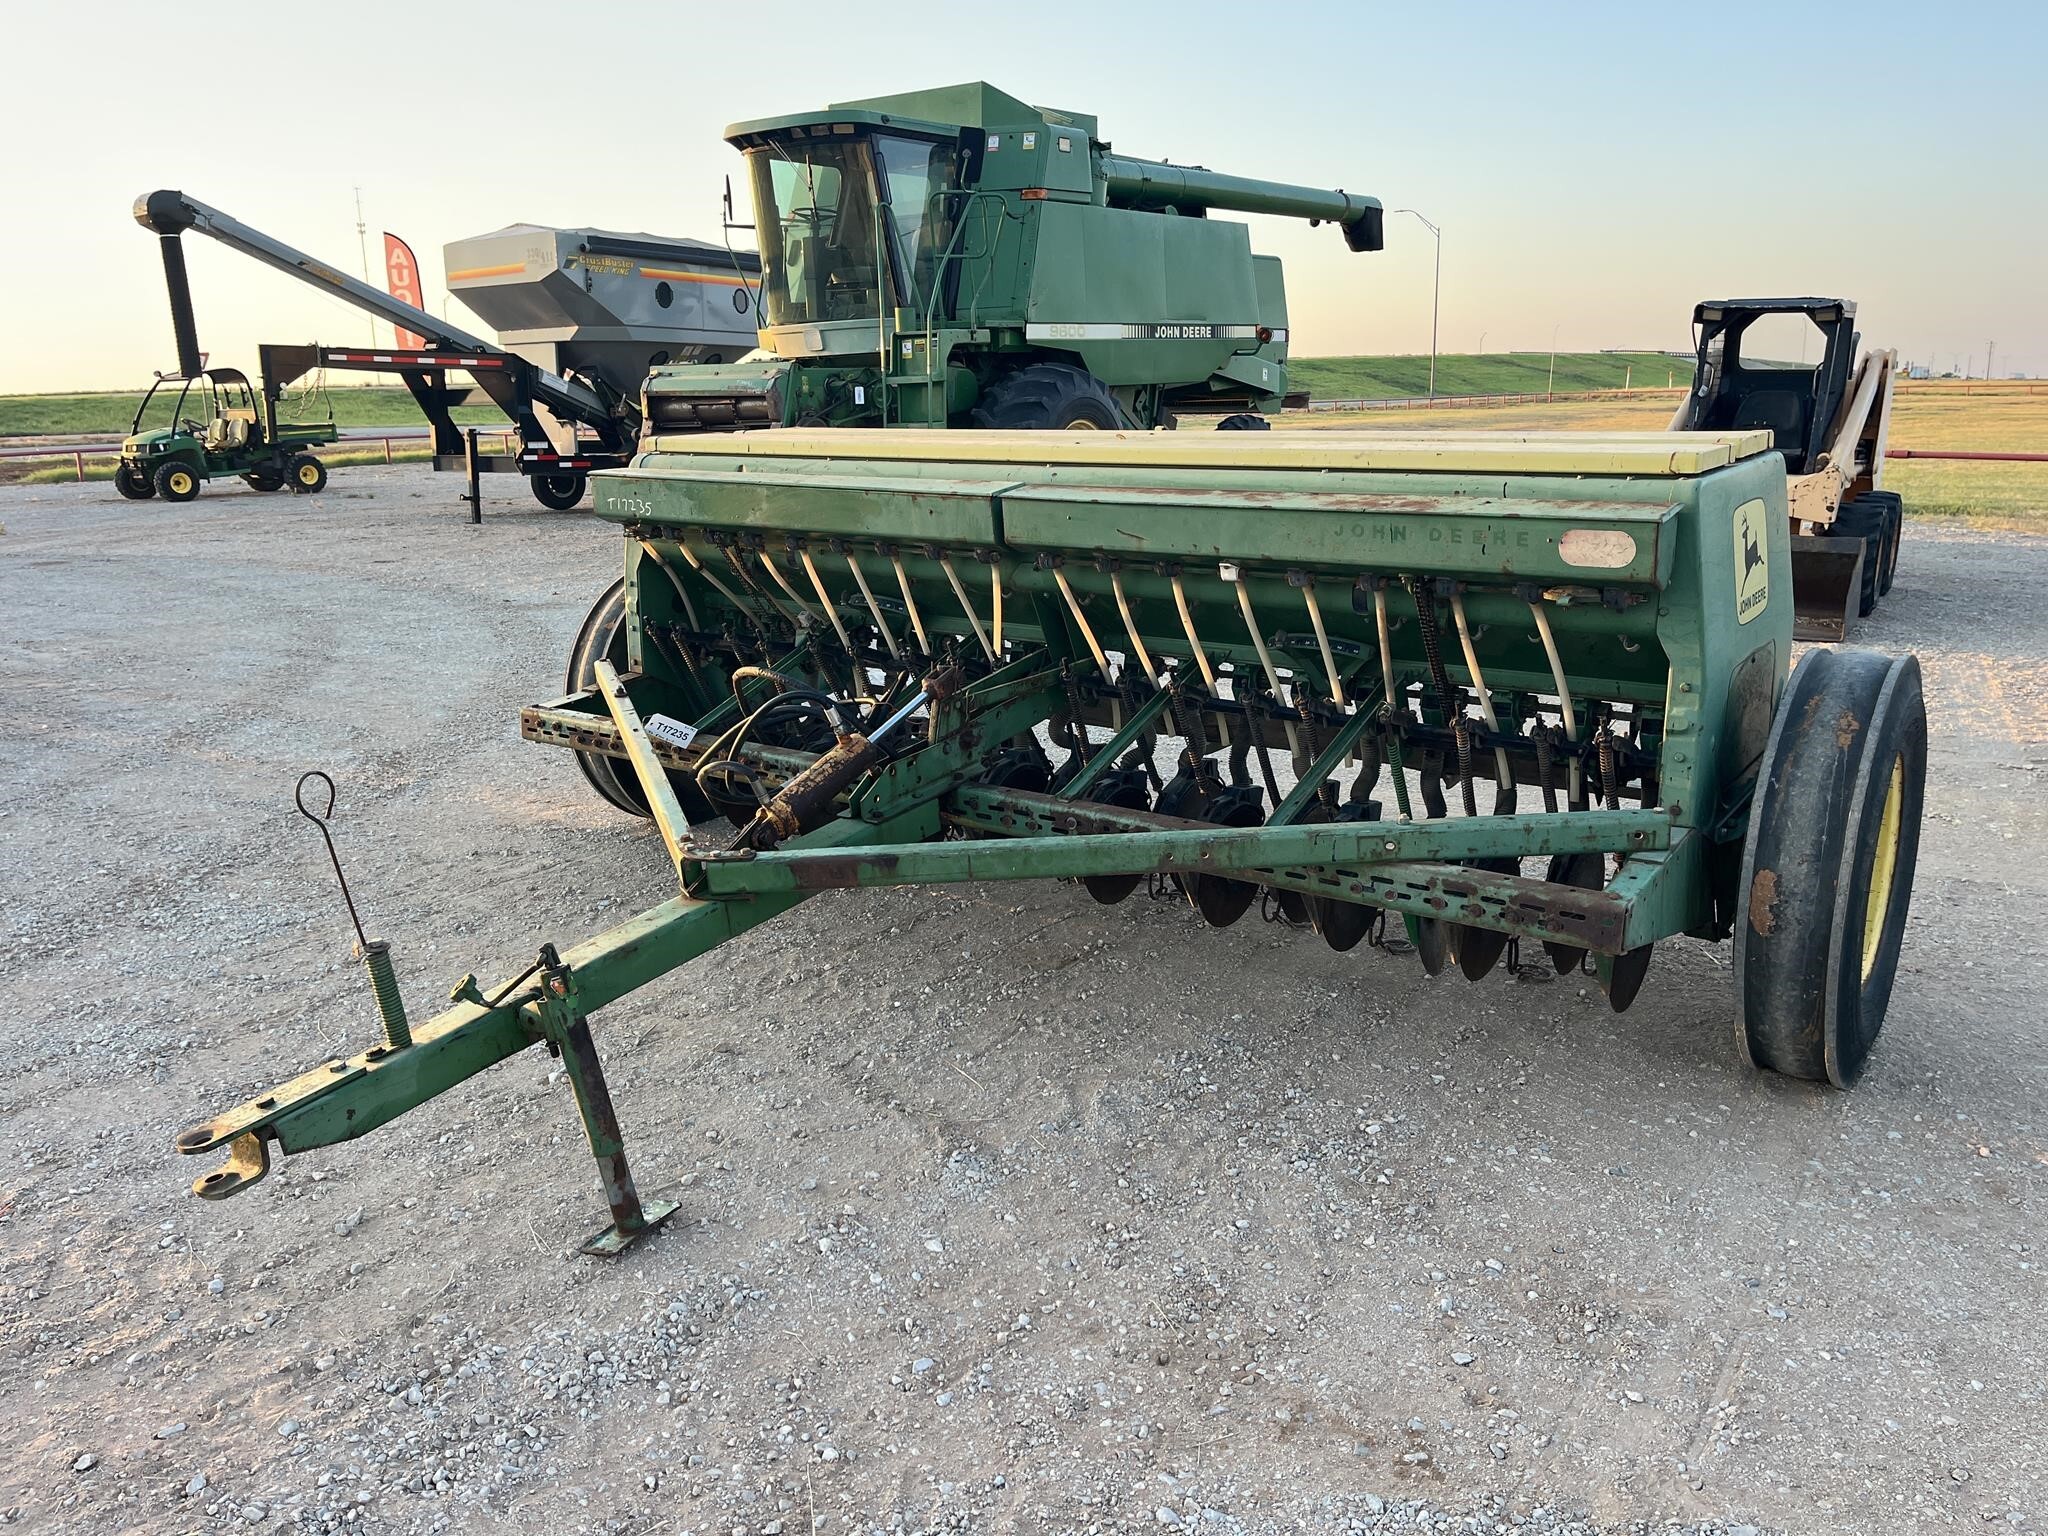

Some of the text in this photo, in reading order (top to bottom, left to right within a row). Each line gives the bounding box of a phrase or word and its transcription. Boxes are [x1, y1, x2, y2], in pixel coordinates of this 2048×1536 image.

[579, 255, 635, 268] CrustBuster
[611, 267, 631, 276] KING
[1154, 325, 1180, 338] JOHN
[1182, 326, 1212, 339] DEERE
[607, 497, 652, 516] T17235
[1334, 523, 1530, 547] JOHN DEERE
[1739, 586, 1766, 616] JOHN DEERE
[656, 722, 690, 741] T17235
